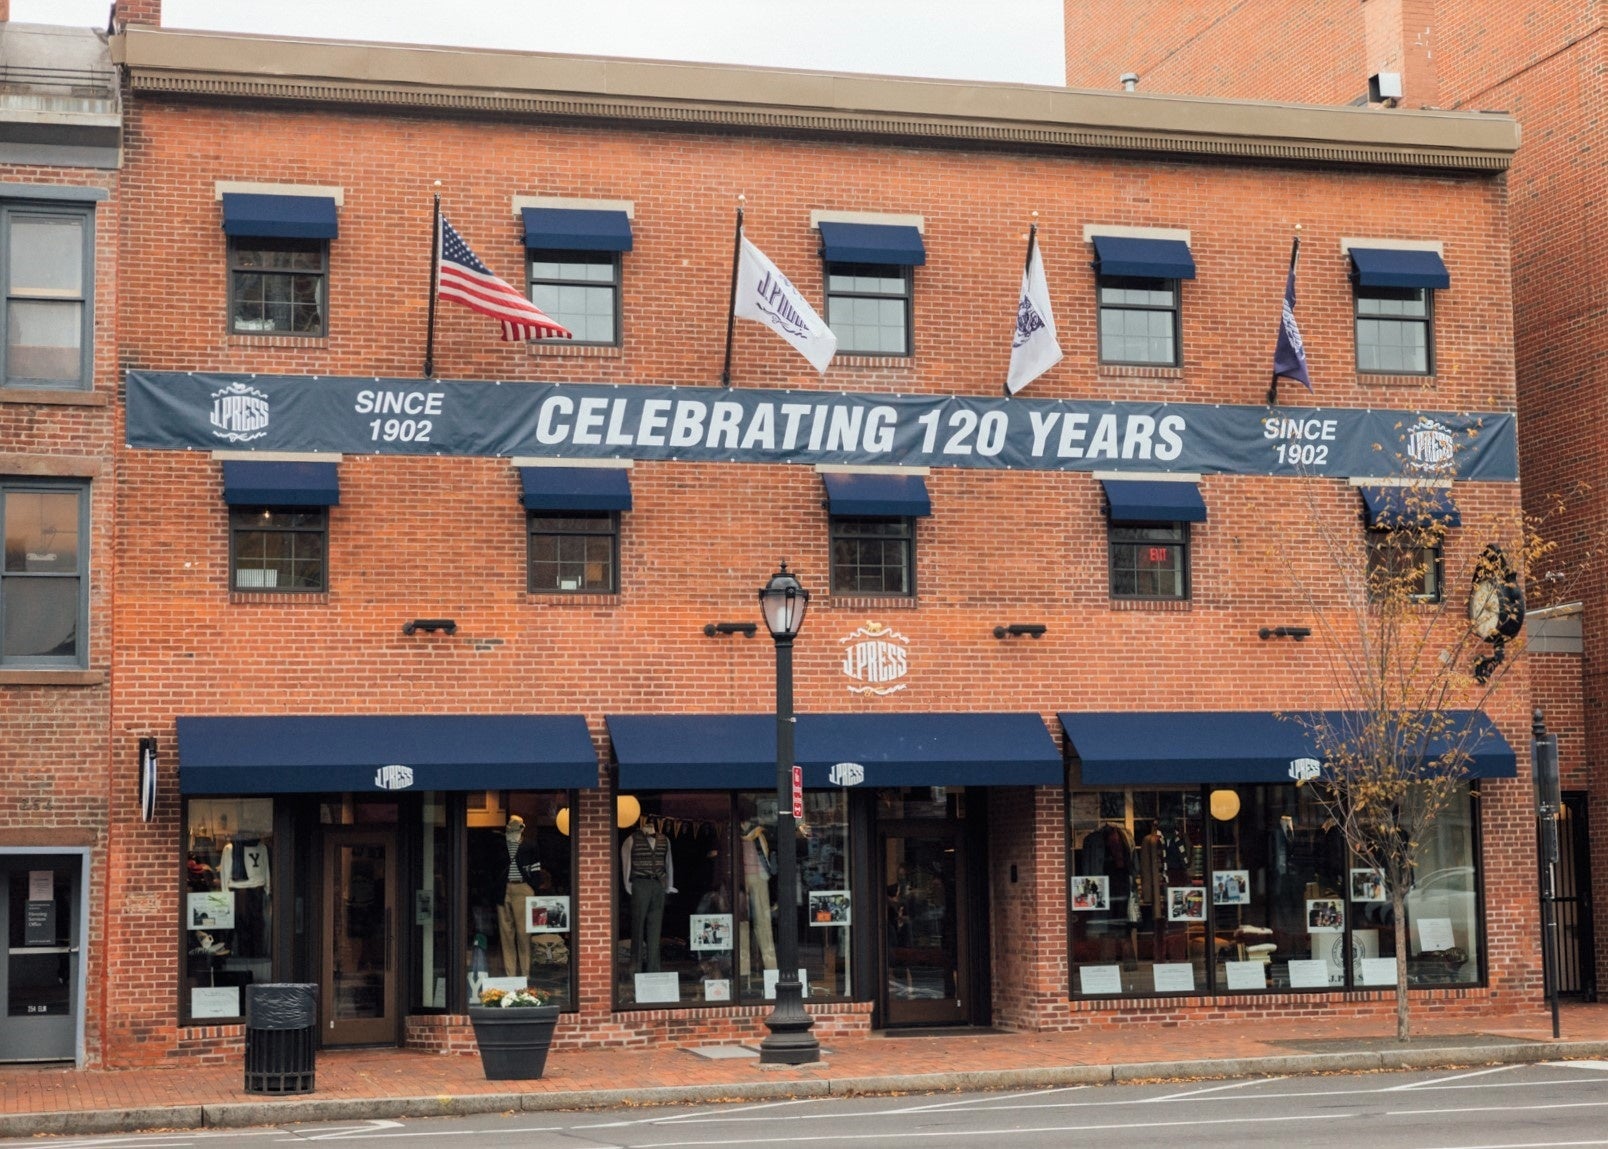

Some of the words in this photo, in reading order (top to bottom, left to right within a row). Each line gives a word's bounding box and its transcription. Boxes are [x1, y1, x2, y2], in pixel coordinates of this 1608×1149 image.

[355, 391, 444, 415] SINCE
[369, 419, 433, 442] 1902
[535, 395, 898, 452] CELEBRATING
[918, 409, 1009, 457] 120
[1028, 411, 1187, 461] YEARS
[1263, 418, 1338, 440] SINCE
[1276, 444, 1329, 465] 1902
[841, 641, 907, 682] J.PRESS
[248, 852, 260, 867] Y
[467, 971, 488, 1004] Y
